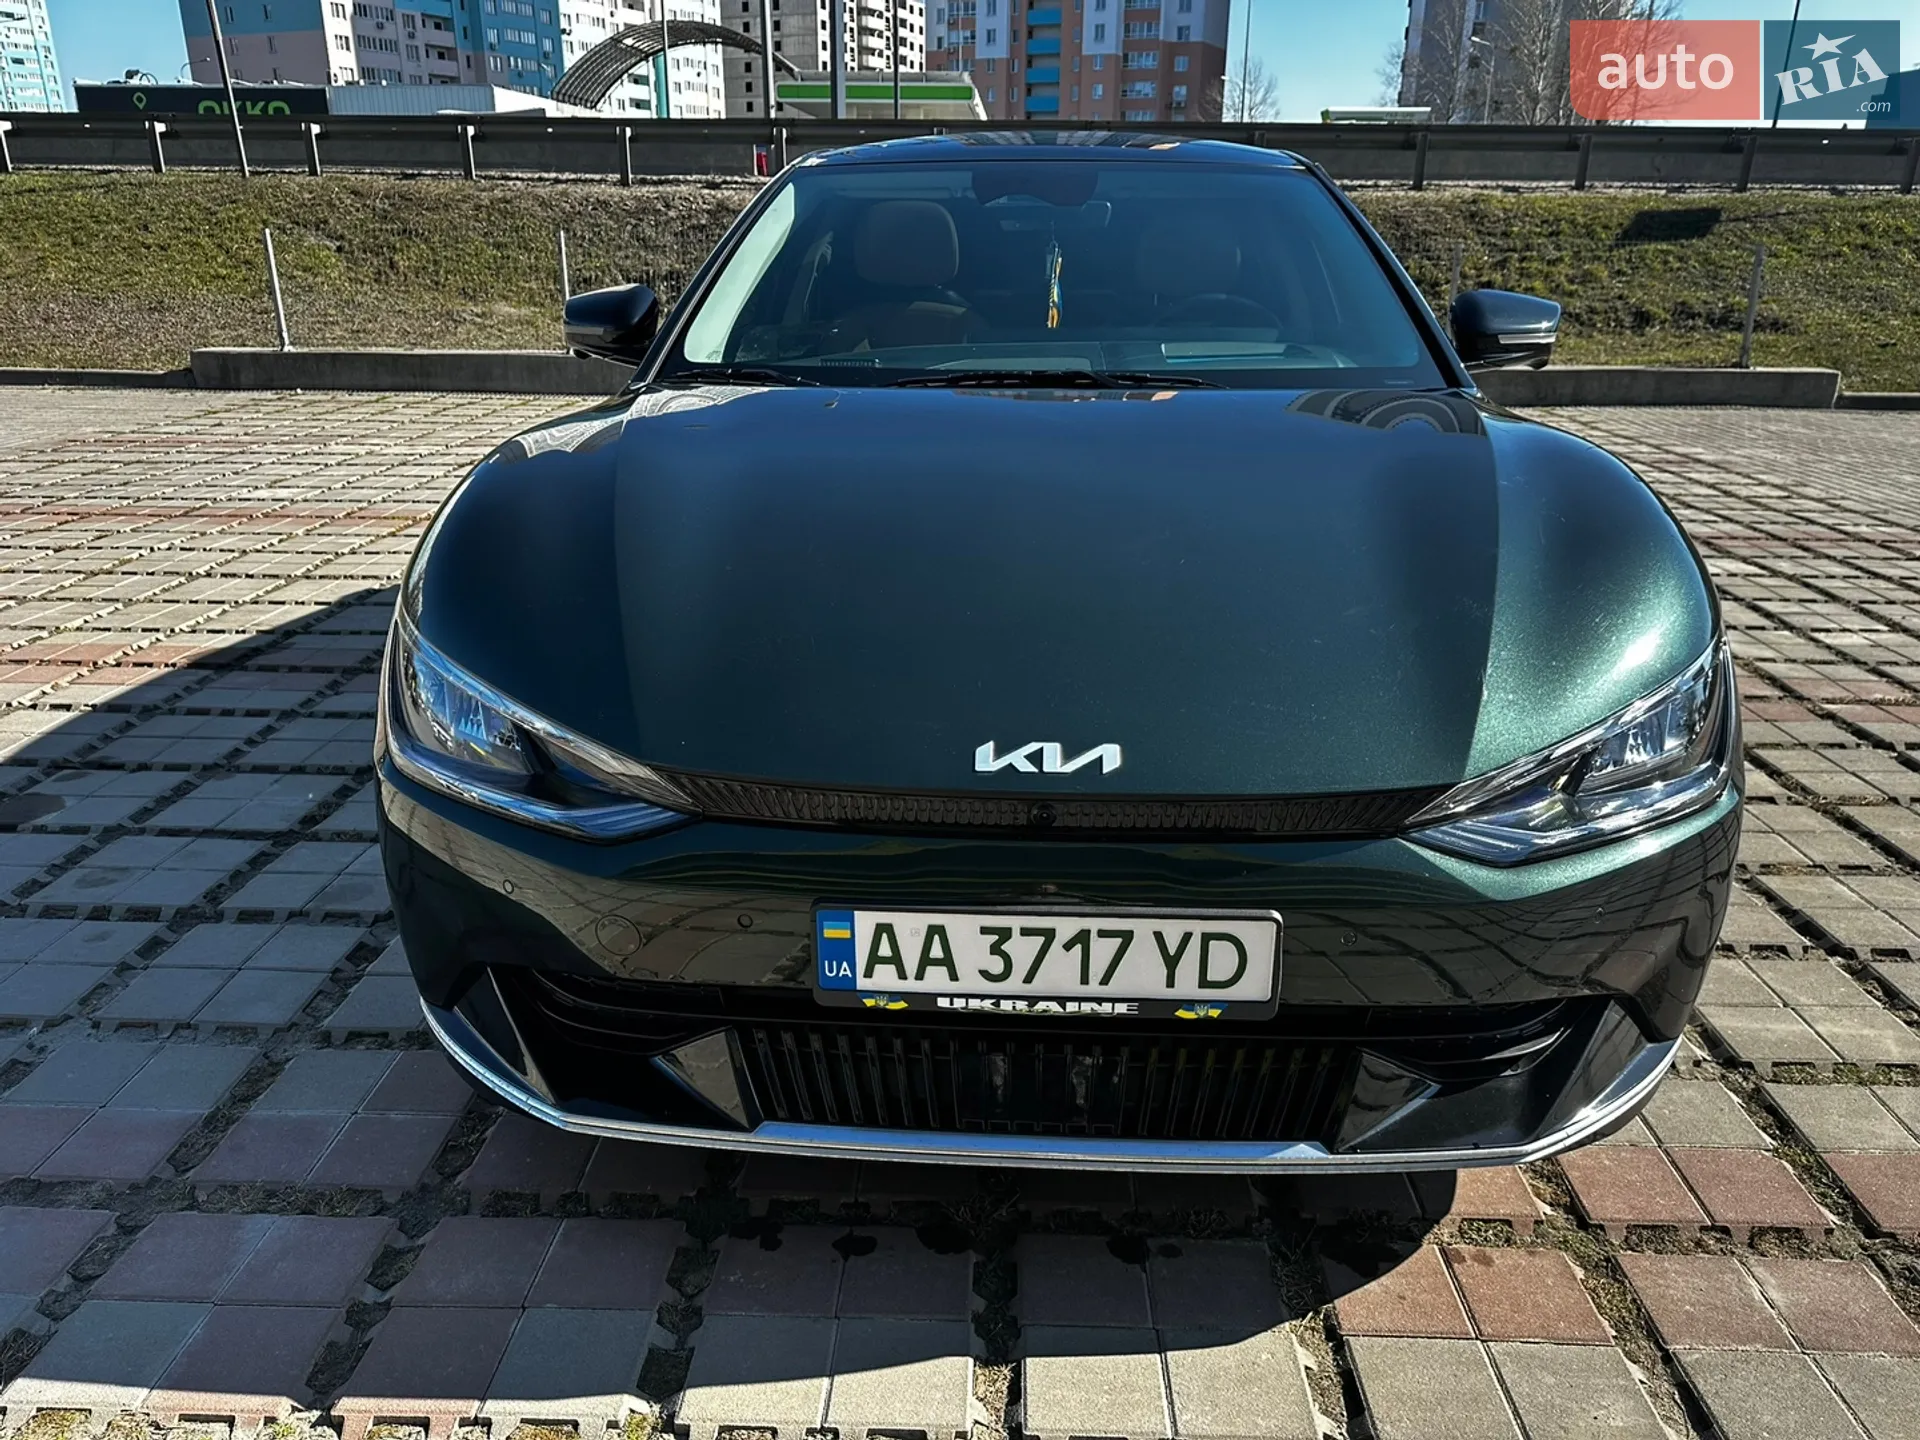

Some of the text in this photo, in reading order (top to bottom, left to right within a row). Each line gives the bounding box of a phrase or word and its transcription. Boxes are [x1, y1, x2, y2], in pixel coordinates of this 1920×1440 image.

[974, 740, 1121, 774] KIA
[824, 960, 852, 978] UA
[863, 923, 1248, 989] AA 3717 YD
[936, 997, 1139, 1015] UKRAINE
